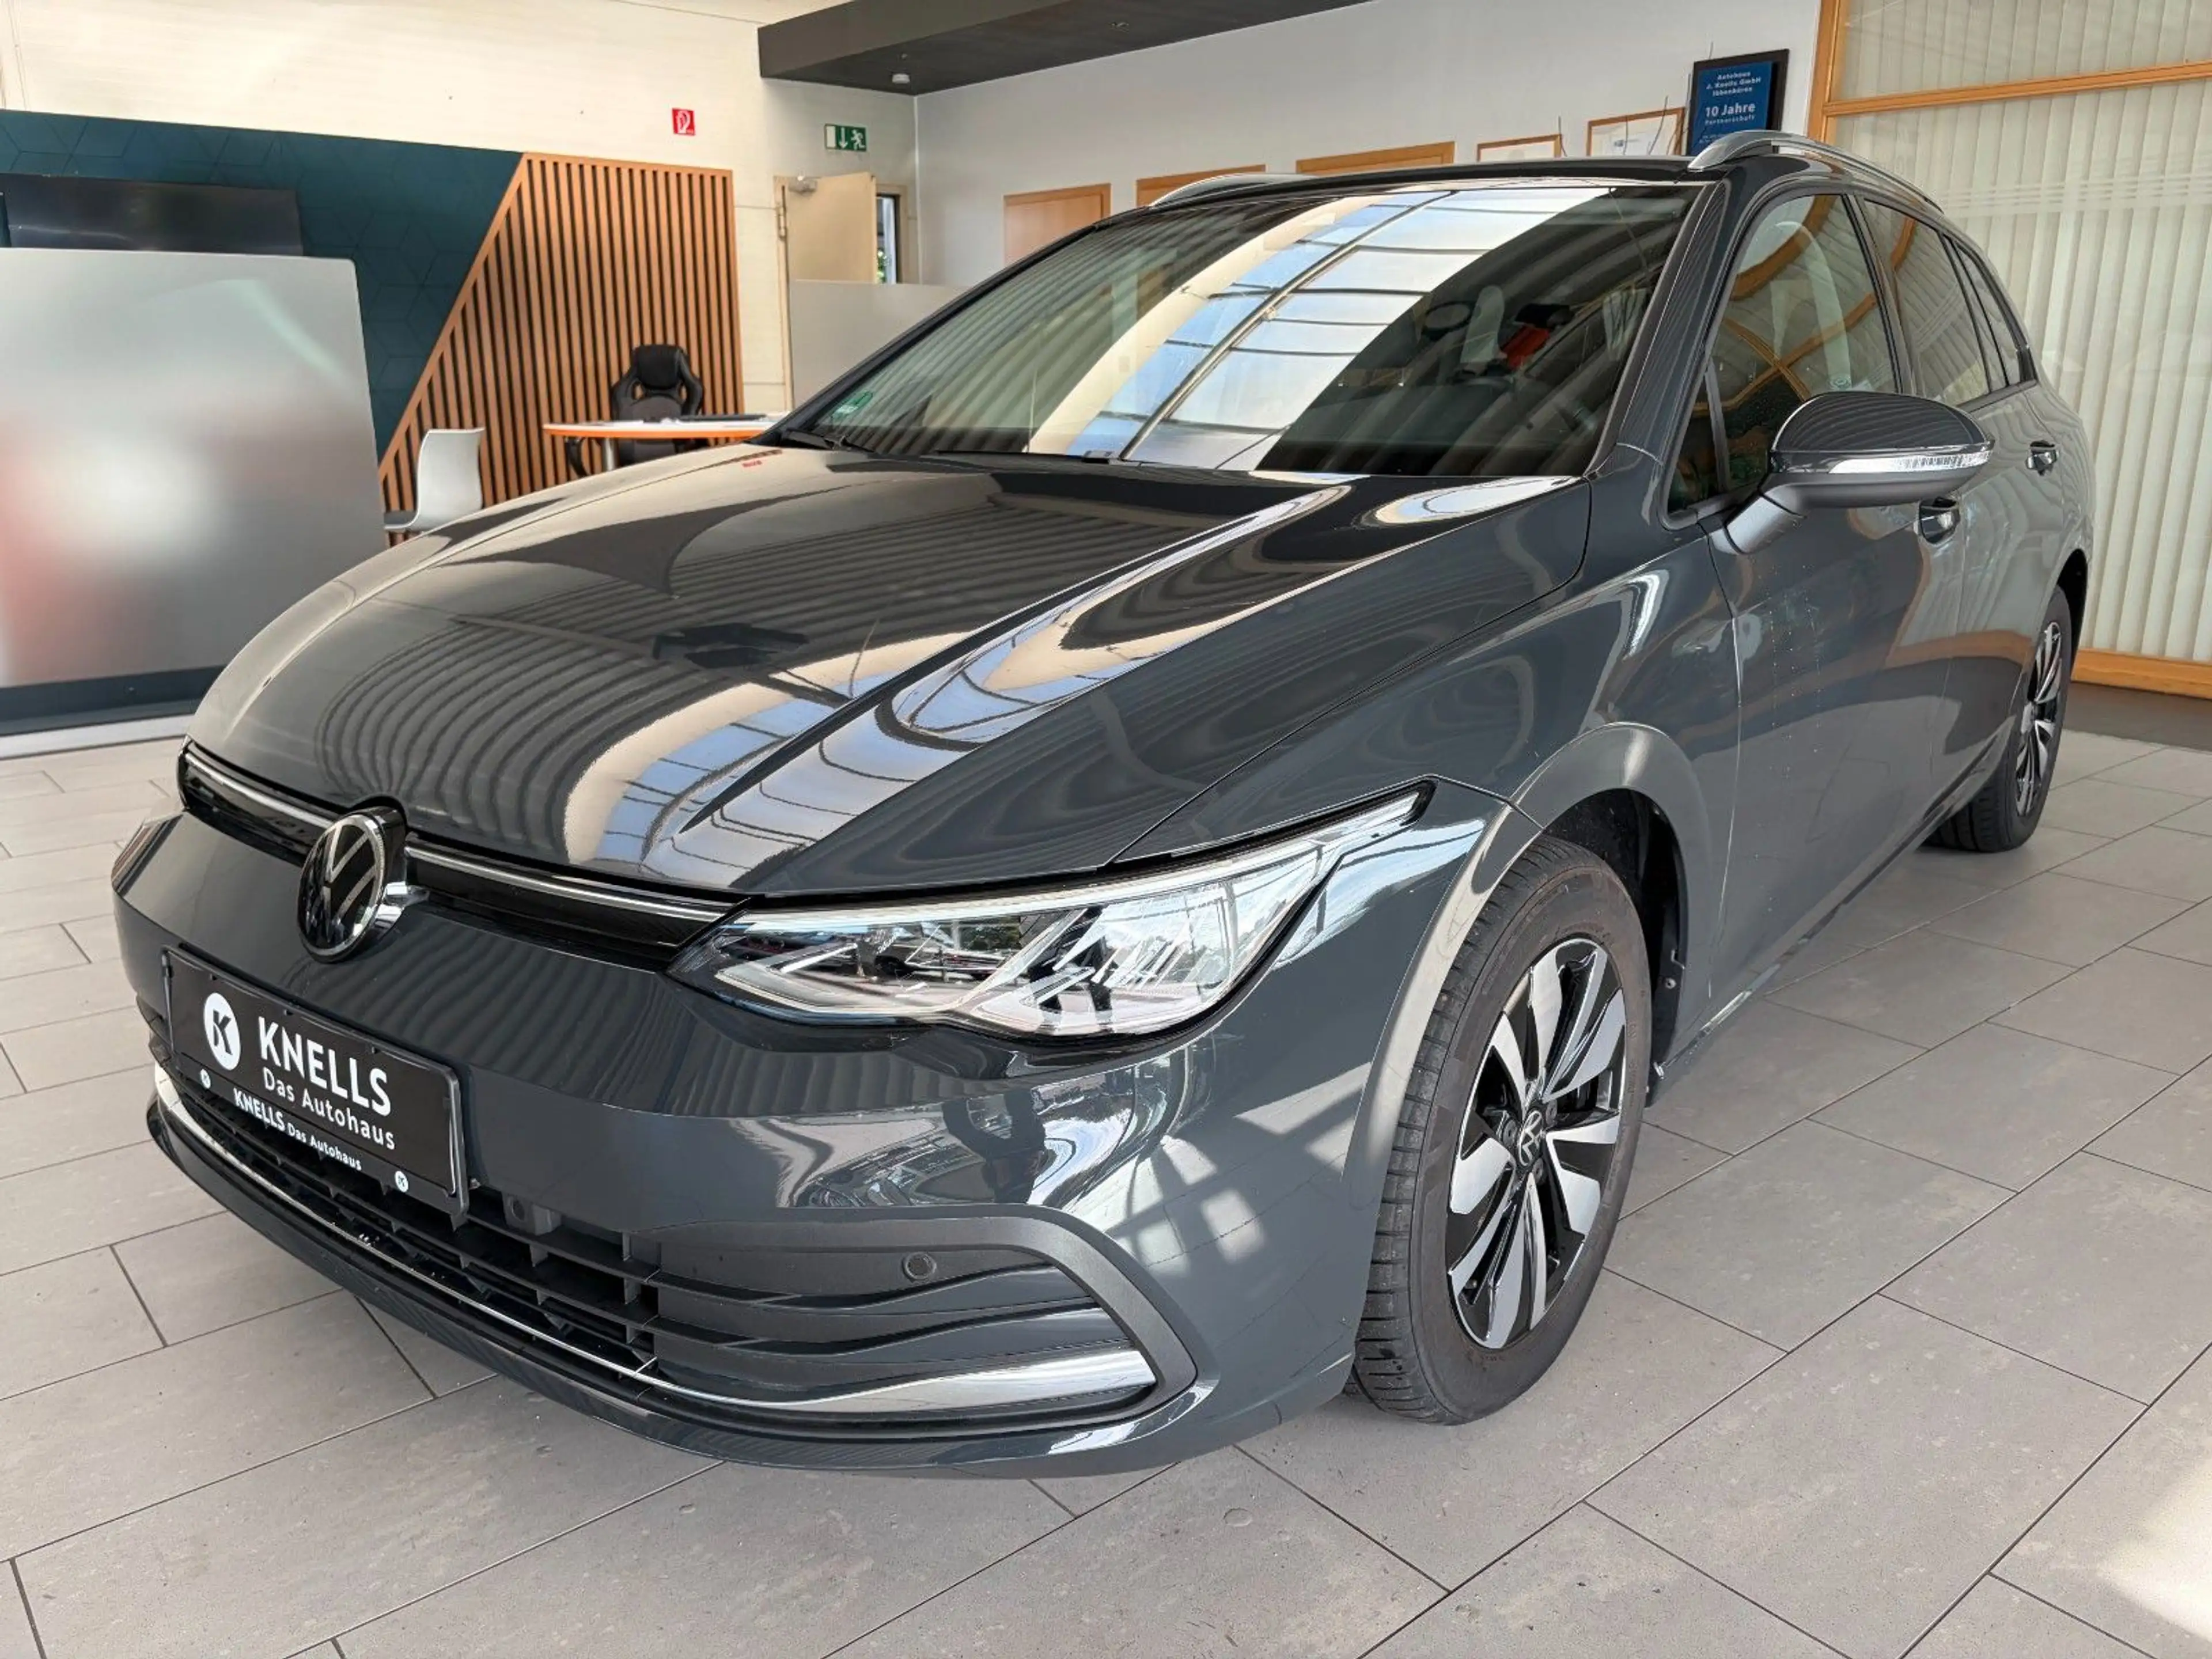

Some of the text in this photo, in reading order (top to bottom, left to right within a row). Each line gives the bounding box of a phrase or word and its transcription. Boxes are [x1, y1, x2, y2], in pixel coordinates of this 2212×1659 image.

[1705, 103, 1756, 118] 10 Jahre
[259, 1016, 391, 1116] KNELLS
[233, 1088, 362, 1171] KNELLS Das Autohaus
[263, 1067, 295, 1102] Das
[302, 1088, 395, 1150] Autohaus
